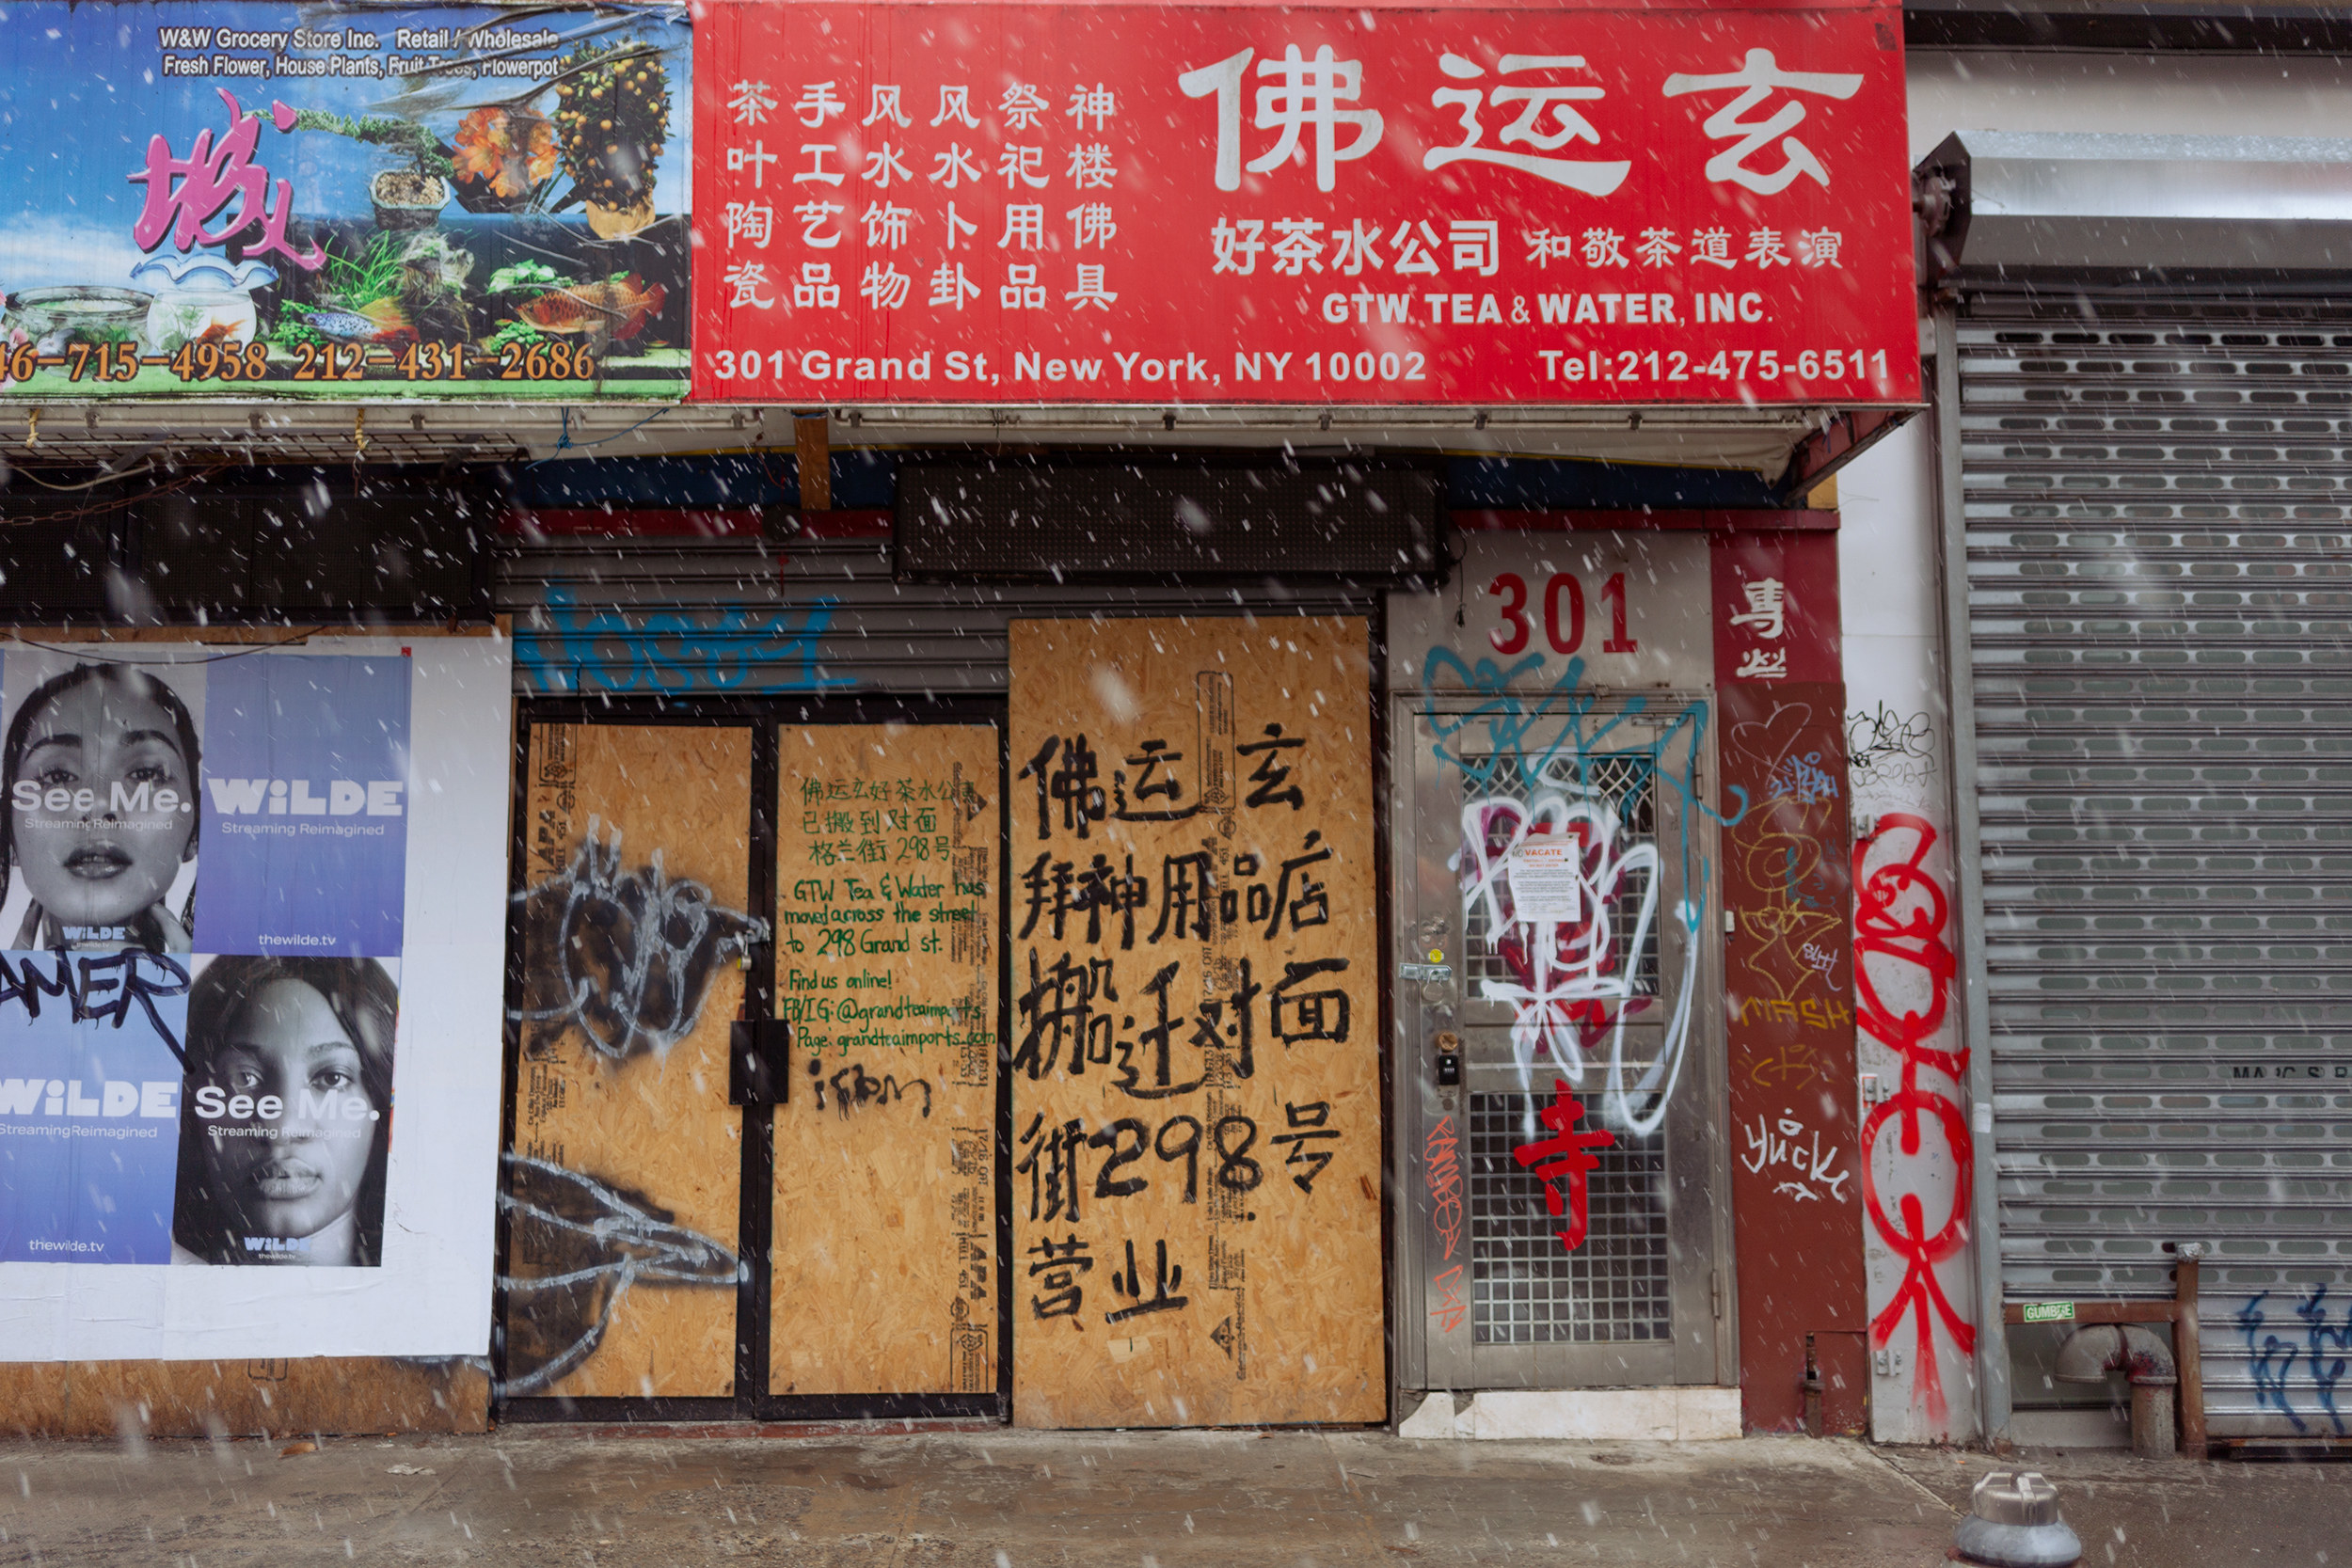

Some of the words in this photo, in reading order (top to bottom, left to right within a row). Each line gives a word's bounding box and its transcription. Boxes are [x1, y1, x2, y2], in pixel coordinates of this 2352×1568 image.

[159, 27, 212, 48] W&W
[216, 27, 288, 53] Grocery
[293, 28, 342, 48] Store
[346, 28, 380, 48] Inc.
[398, 28, 449, 48] Retail
[469, 29, 560, 49] Wholesale
[164, 55, 209, 75] Fresh
[214, 55, 271, 78] Flower,
[276, 55, 326, 75] House
[330, 56, 384, 78] Plants,
[723, 78, 779, 309] 茶叶陶瓷
[792, 80, 847, 309] 手工艺品
[860, 84, 914, 310] 风水饰物
[928, 84, 982, 311] 风水卜卦
[997, 80, 1051, 310] 祭祀用品
[1064, 81, 1119, 312] 神楼佛具
[1210, 217, 1500, 277] 好茶水公司
[1526, 225, 1845, 271] 和敬茶道表演
[1323, 293, 1410, 325] GTW
[1423, 293, 1503, 325] TEA
[1511, 295, 1532, 325] &
[1537, 293, 1686, 328] WATER,
[1695, 293, 1774, 324] INC.
[715, 349, 784, 381] 301
[800, 349, 932, 382] Grand
[943, 350, 1000, 387] St,
[1013, 352, 1104, 382] New
[1119, 352, 1222, 387] York,
[1234, 353, 1292, 381] NY
[1305, 351, 1427, 382] 10002
[1539, 347, 1890, 382] Tel:212-475-6511
[1488, 571, 1638, 655] 301
[11, 779, 95, 813] See
[109, 781, 192, 814] Me.
[1018, 722, 1307, 840] 佛运玄
[24, 817, 91, 832] Streaming
[93, 818, 173, 832] Reimagined
[220, 821, 296, 838] Streaming
[299, 822, 385, 838] Reimagined
[802, 807, 937, 835] 已搬到对面
[1525, 848, 1563, 857] VACATE
[793, 879, 834, 903] GTW
[844, 878, 875, 900] Tea
[879, 872, 892, 901] &
[895, 874, 946, 899] Water
[955, 872, 987, 896] has
[1018, 830, 1335, 952] 拜神用品店
[784, 904, 829, 926] moved
[831, 907, 885, 923] across
[893, 901, 921, 923] the
[929, 900, 979, 924] street
[258, 933, 337, 947] thewilde.tv
[786, 927, 805, 954] to
[816, 927, 855, 957] 298
[860, 928, 910, 955] Grand
[788, 968, 818, 991] Find
[820, 976, 838, 990] us
[846, 968, 893, 990] online!
[1740, 995, 1851, 1030] MASH
[194, 1085, 283, 1119] See
[297, 1087, 381, 1121] Me.
[0, 1123, 71, 1138] Streaming
[72, 1125, 158, 1140] Reimagined
[207, 1125, 278, 1140] Streaming
[282, 1128, 361, 1141] Reimagined
[28, 1239, 105, 1253] thewilde.tv
[1026, 1233, 1190, 1324] 营业
